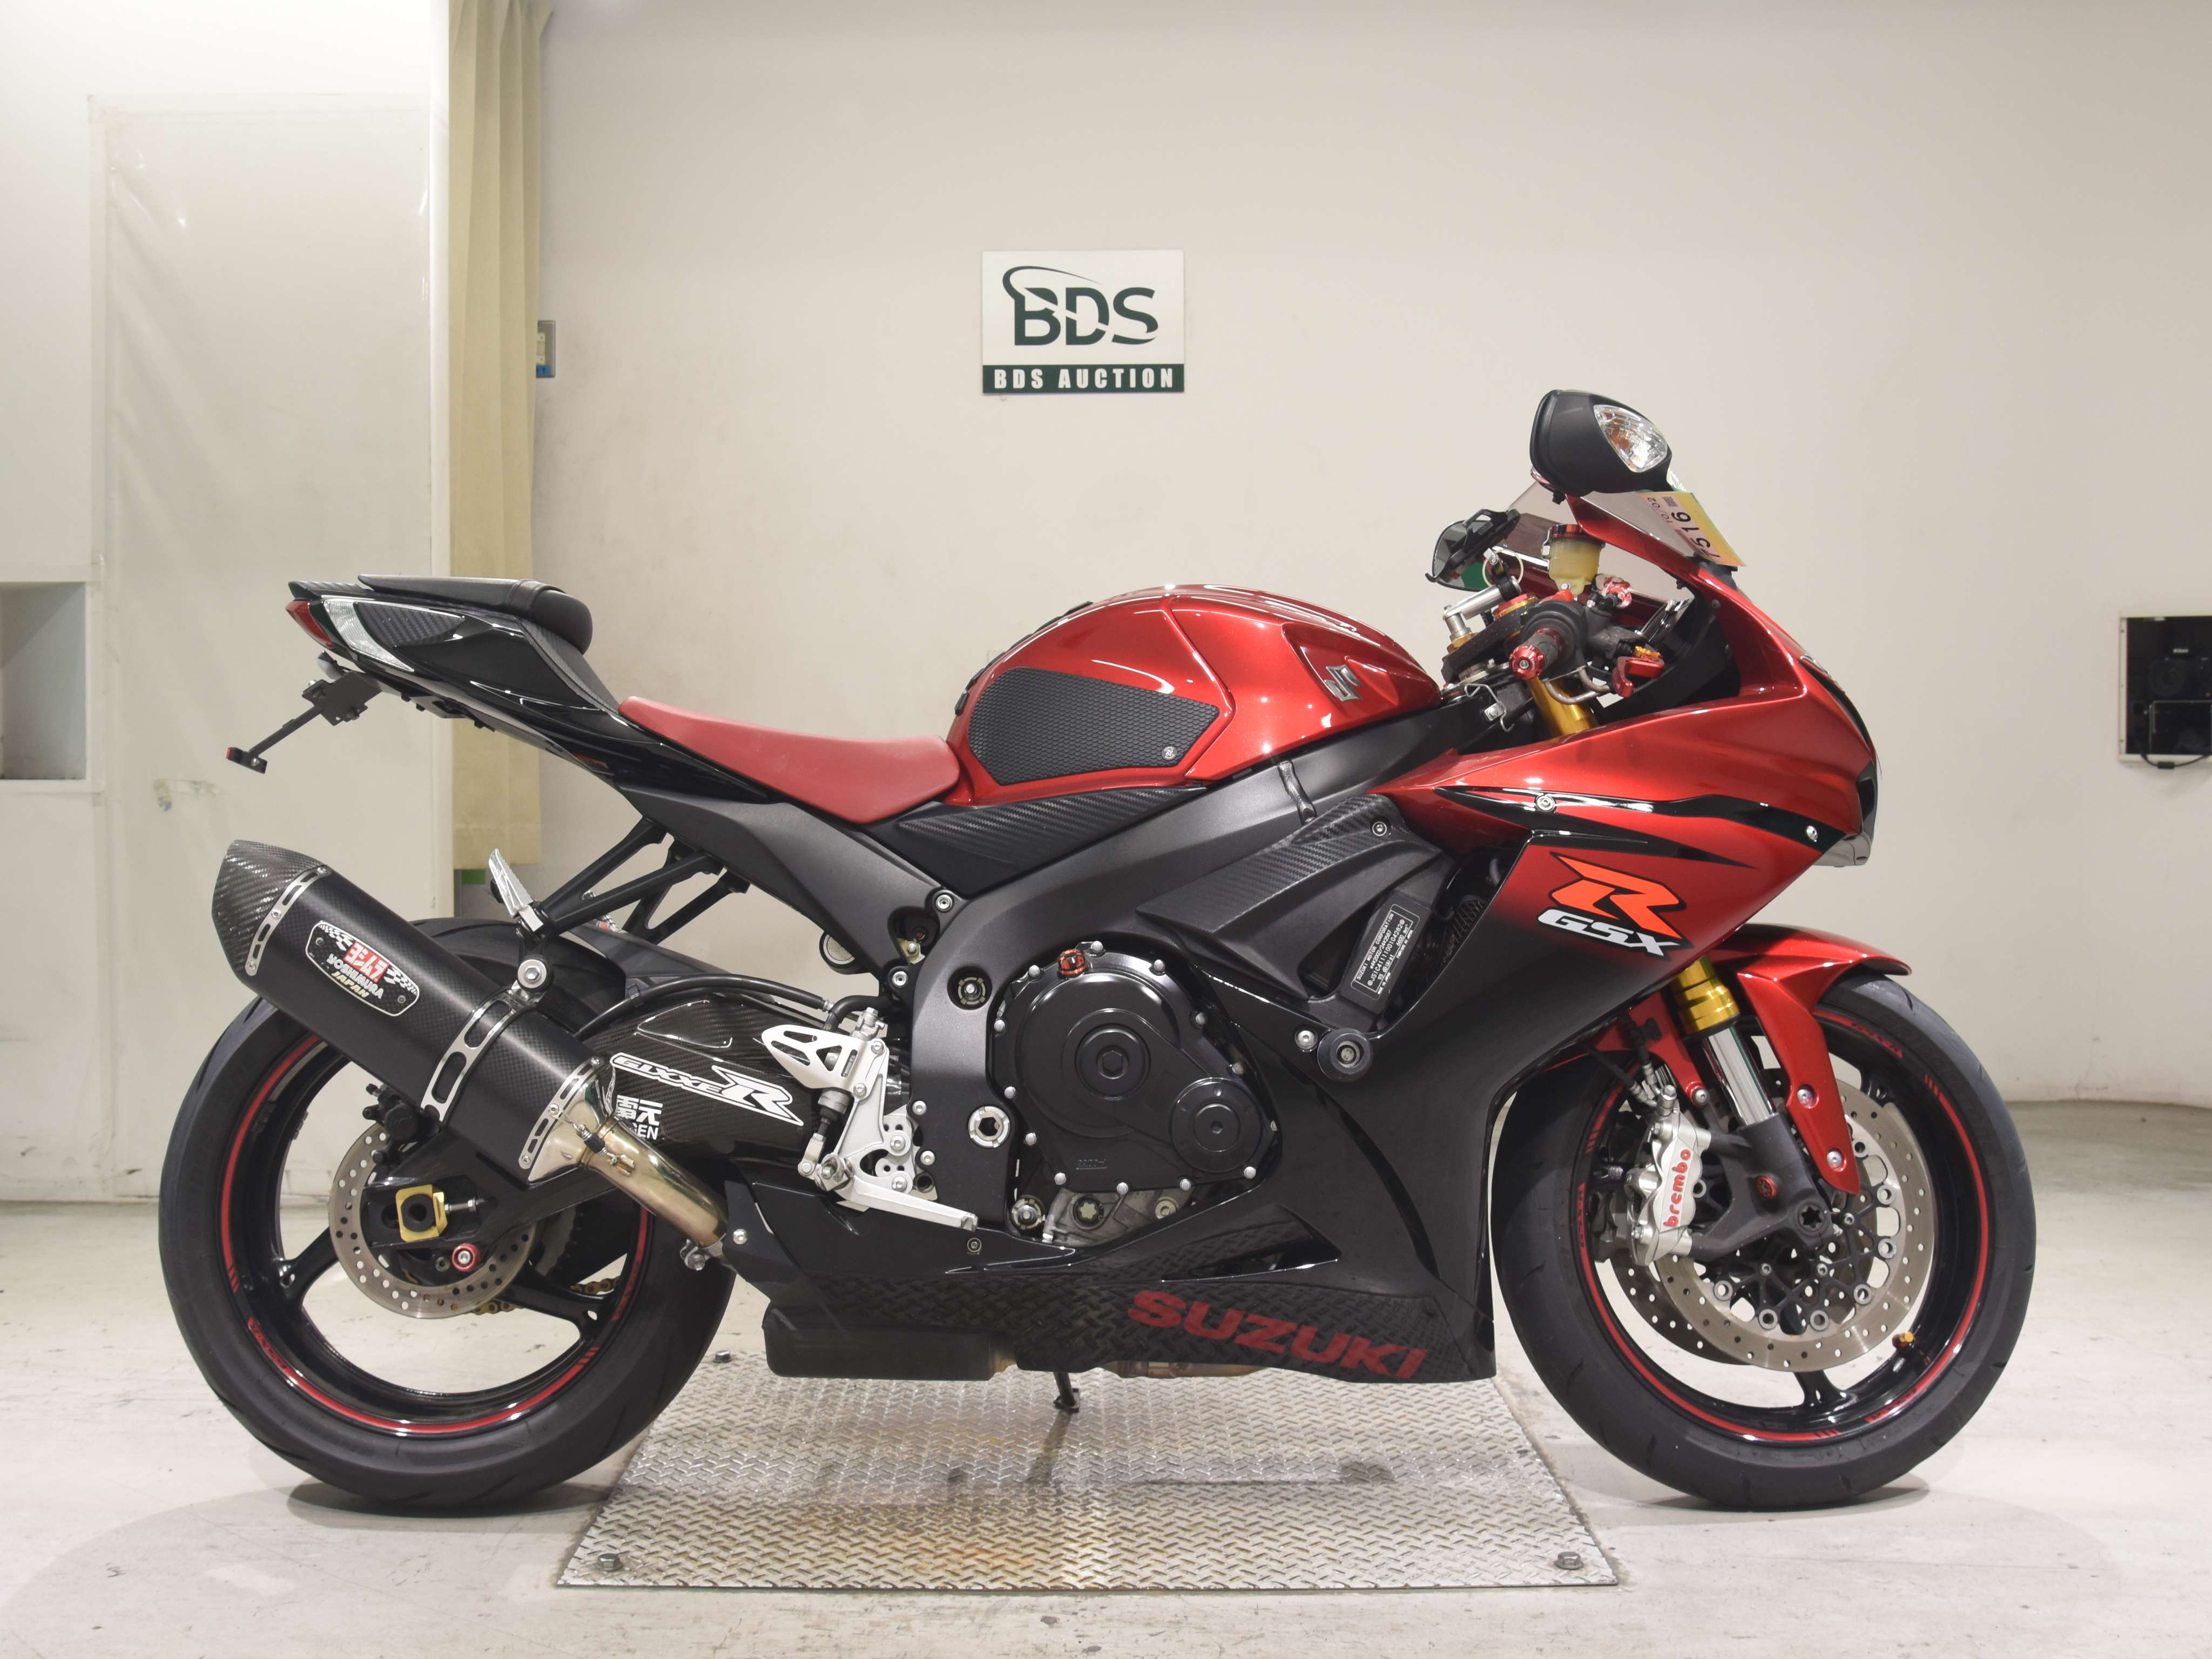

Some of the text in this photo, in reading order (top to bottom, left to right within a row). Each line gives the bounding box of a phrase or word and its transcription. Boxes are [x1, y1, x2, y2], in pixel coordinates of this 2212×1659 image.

[1002, 266, 1159, 346] BDS
[994, 368, 1173, 389] BDS AUCTION
[1357, 913, 1394, 980] SUZUKI MOTOR CORPORATION
[1538, 909, 1681, 956] GSX
[326, 953, 384, 1000] YOSHIMURA
[331, 971, 370, 998] JAPAN
[345, 942, 390, 982] ヨシムラ
[1663, 1149, 1691, 1228] brembo
[1127, 1290, 1406, 1379] SUZUKI
